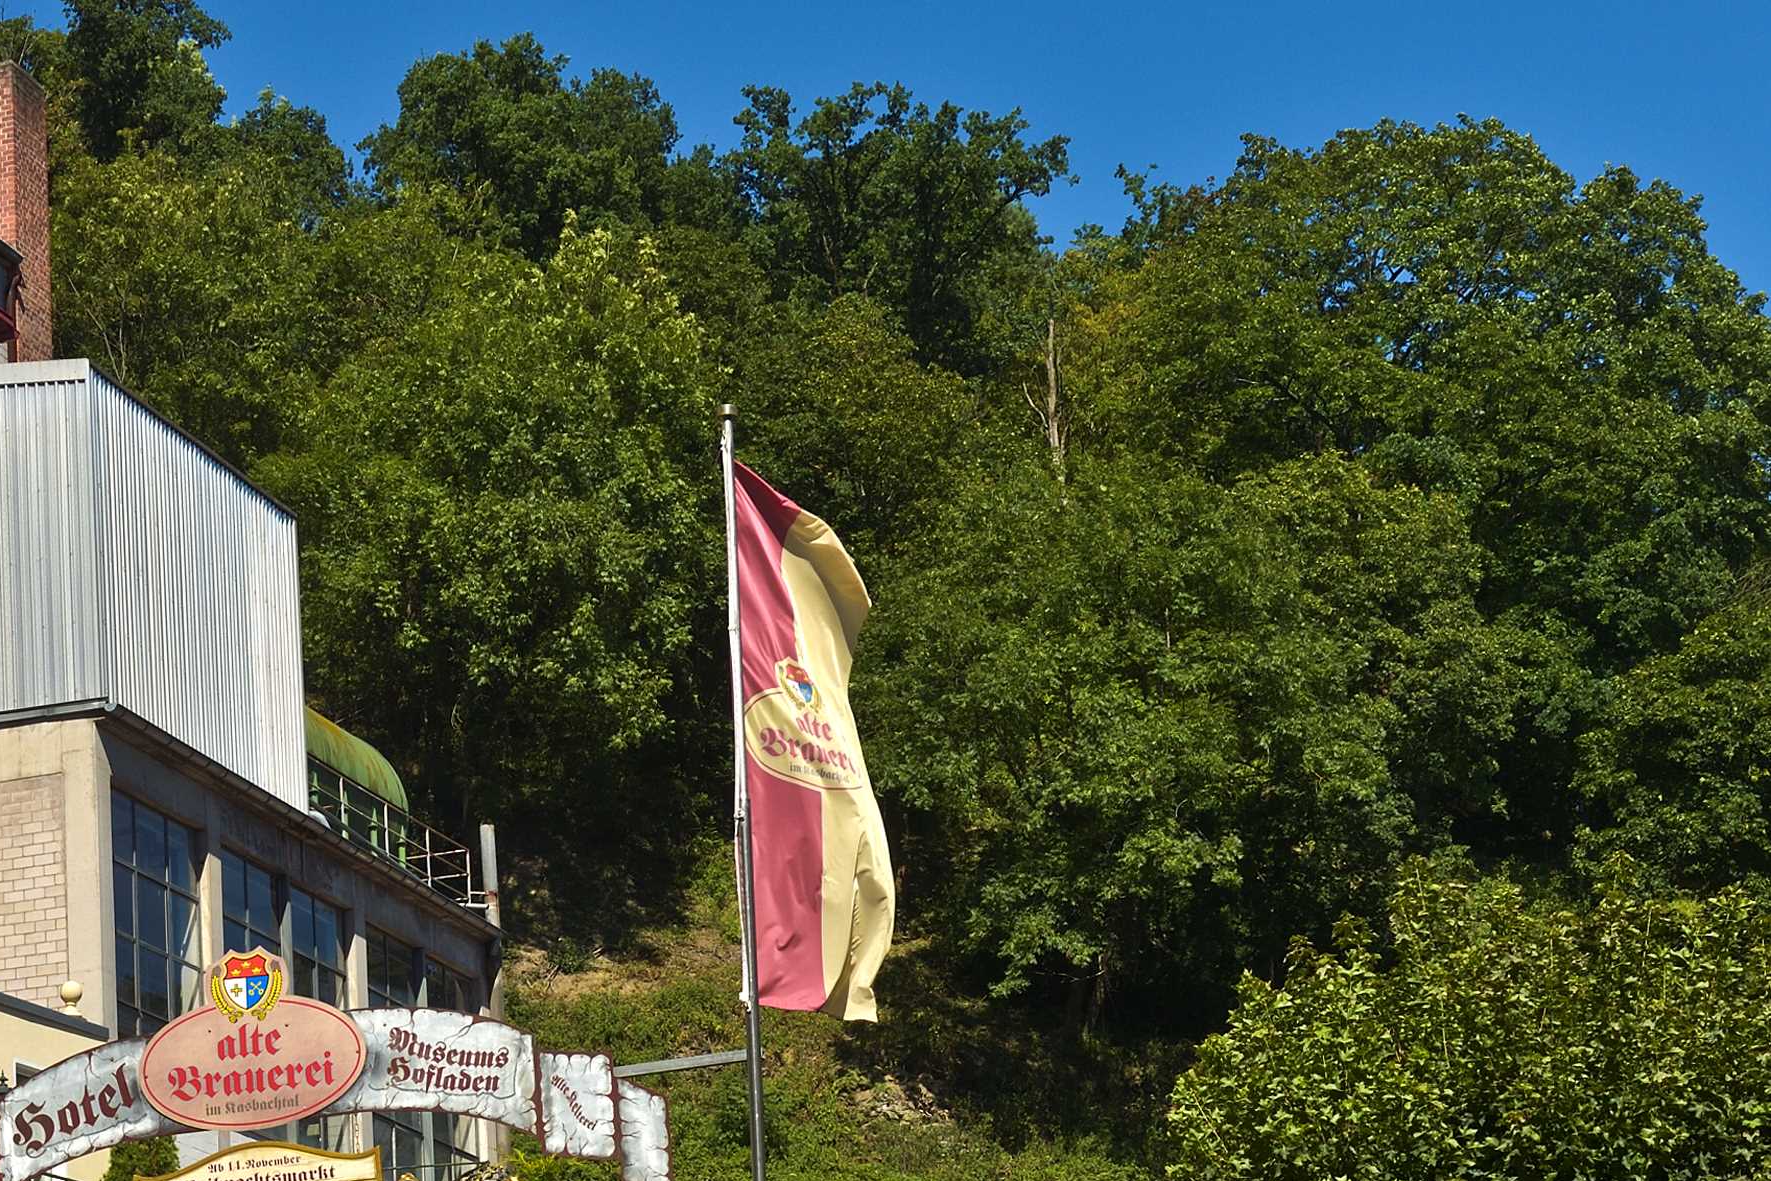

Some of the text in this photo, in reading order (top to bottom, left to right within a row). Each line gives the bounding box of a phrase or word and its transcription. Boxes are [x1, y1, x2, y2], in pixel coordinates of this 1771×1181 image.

[796, 712, 833, 741] alte
[217, 1023, 281, 1061] alte
[388, 1027, 509, 1068] Museums
[167, 1051, 335, 1102] Brauerei
[388, 1056, 501, 1093] Hofladen
[13, 1063, 133, 1158] Hotel
[205, 1094, 299, 1116] im Kasbachtal
[207, 1163, 224, 1173] Ab
